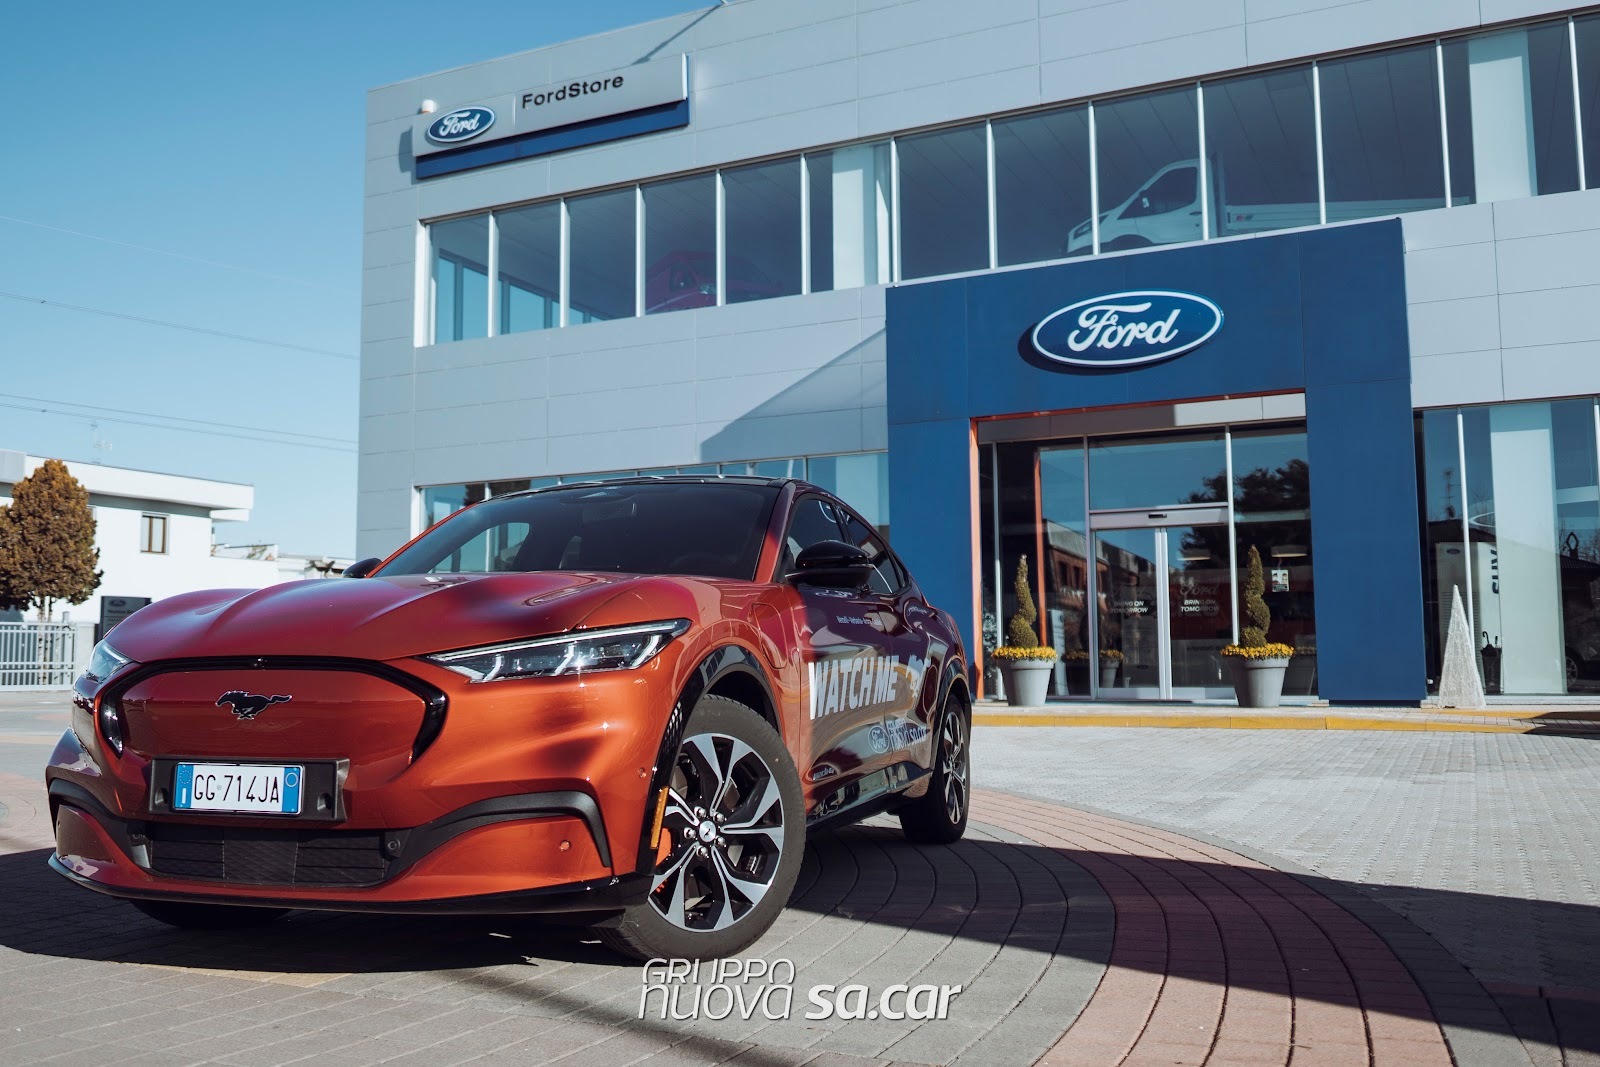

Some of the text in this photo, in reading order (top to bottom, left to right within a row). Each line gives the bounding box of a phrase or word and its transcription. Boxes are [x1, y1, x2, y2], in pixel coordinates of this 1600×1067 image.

[522, 75, 624, 109] FordStore
[439, 111, 480, 137] Ford
[1067, 301, 1182, 353] Ford
[808, 655, 900, 721] WATCH ME
